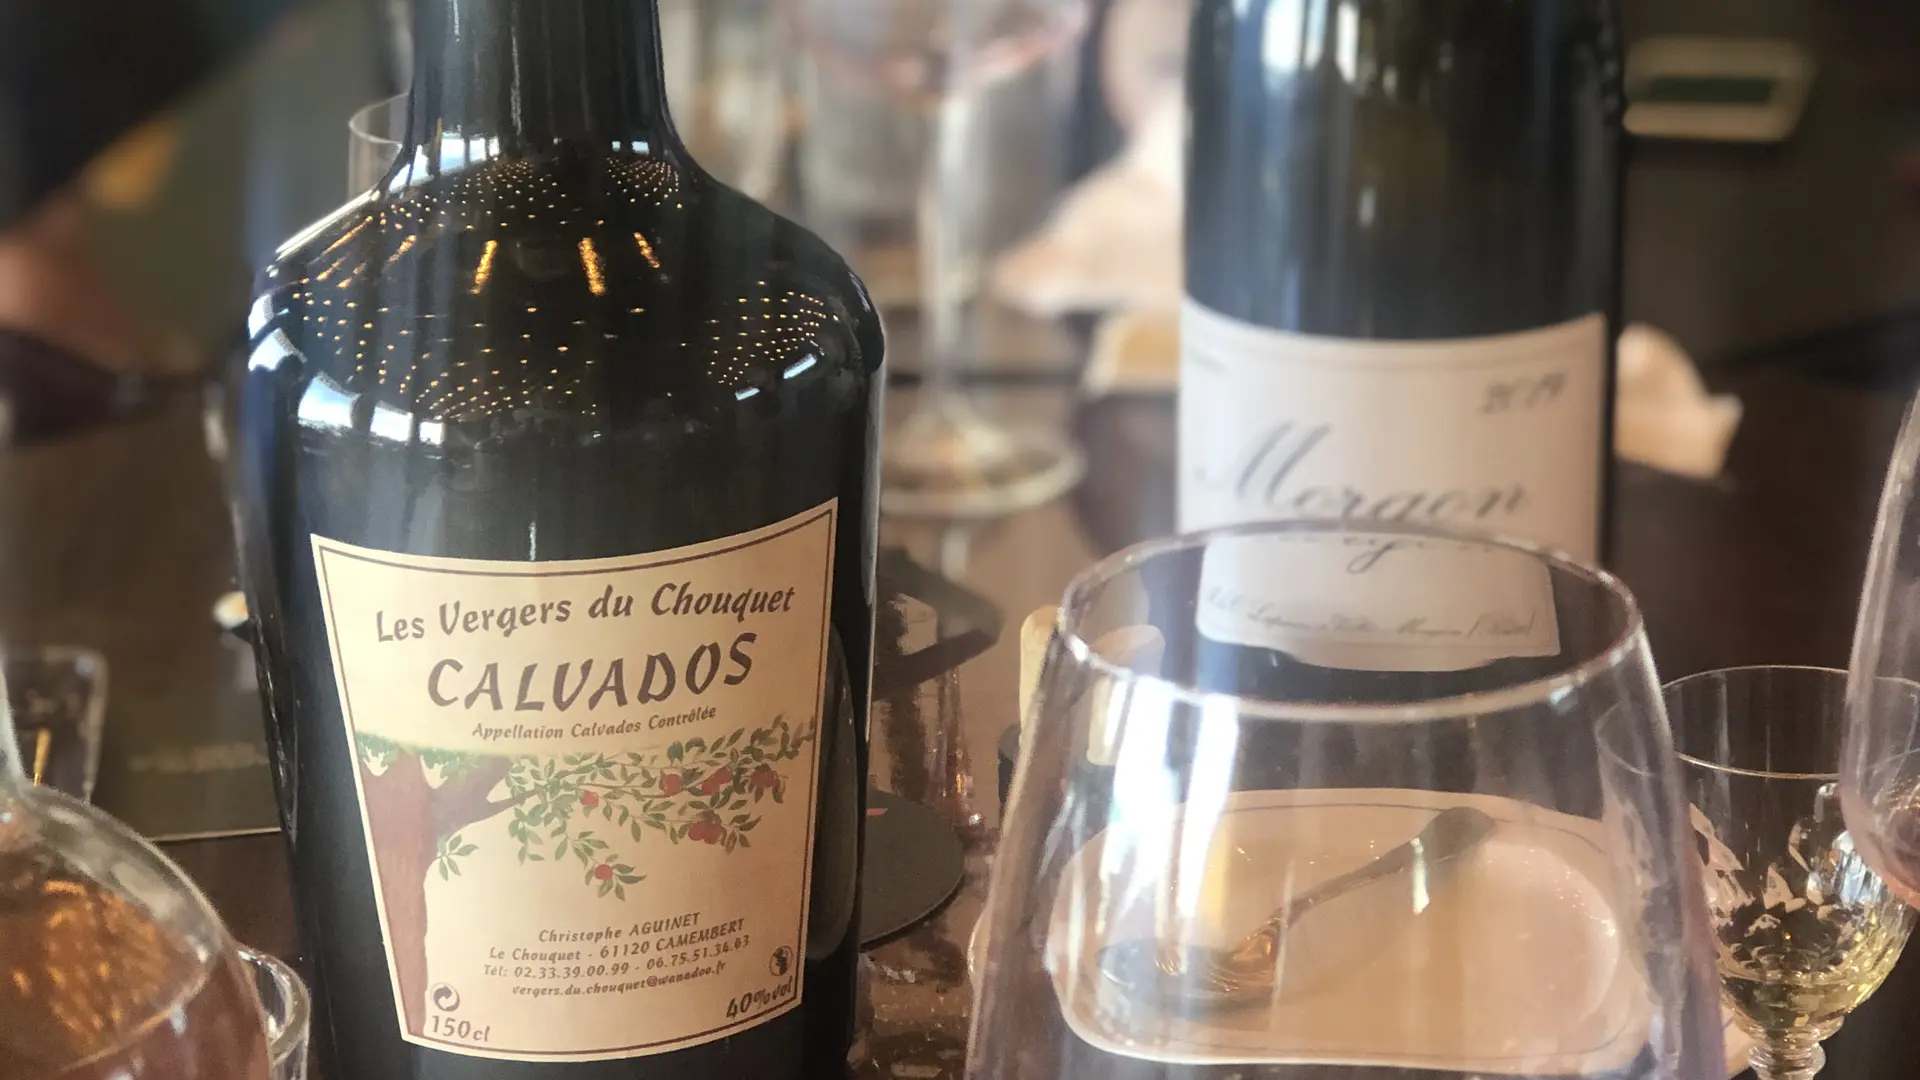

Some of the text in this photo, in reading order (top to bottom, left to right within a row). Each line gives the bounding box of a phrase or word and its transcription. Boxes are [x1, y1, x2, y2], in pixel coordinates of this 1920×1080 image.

[1196, 421, 1528, 532] Morgon
[375, 580, 796, 642] Les Vergers du Chouquet
[427, 631, 759, 713] CALVADOS
[471, 704, 718, 742] Appellation Calvados Contrôlée
[489, 946, 506, 960] Le
[512, 947, 581, 964] Chouquet
[599, 941, 651, 959] 61120
[655, 918, 745, 953] CAMEMBERT
[538, 911, 701, 943] Christophe AGUINET
[484, 964, 508, 977] Tél:
[514, 962, 630, 980] 02.33.39.00.99
[512, 959, 727, 998] vergers.du.chouquet@wanadoo.fr
